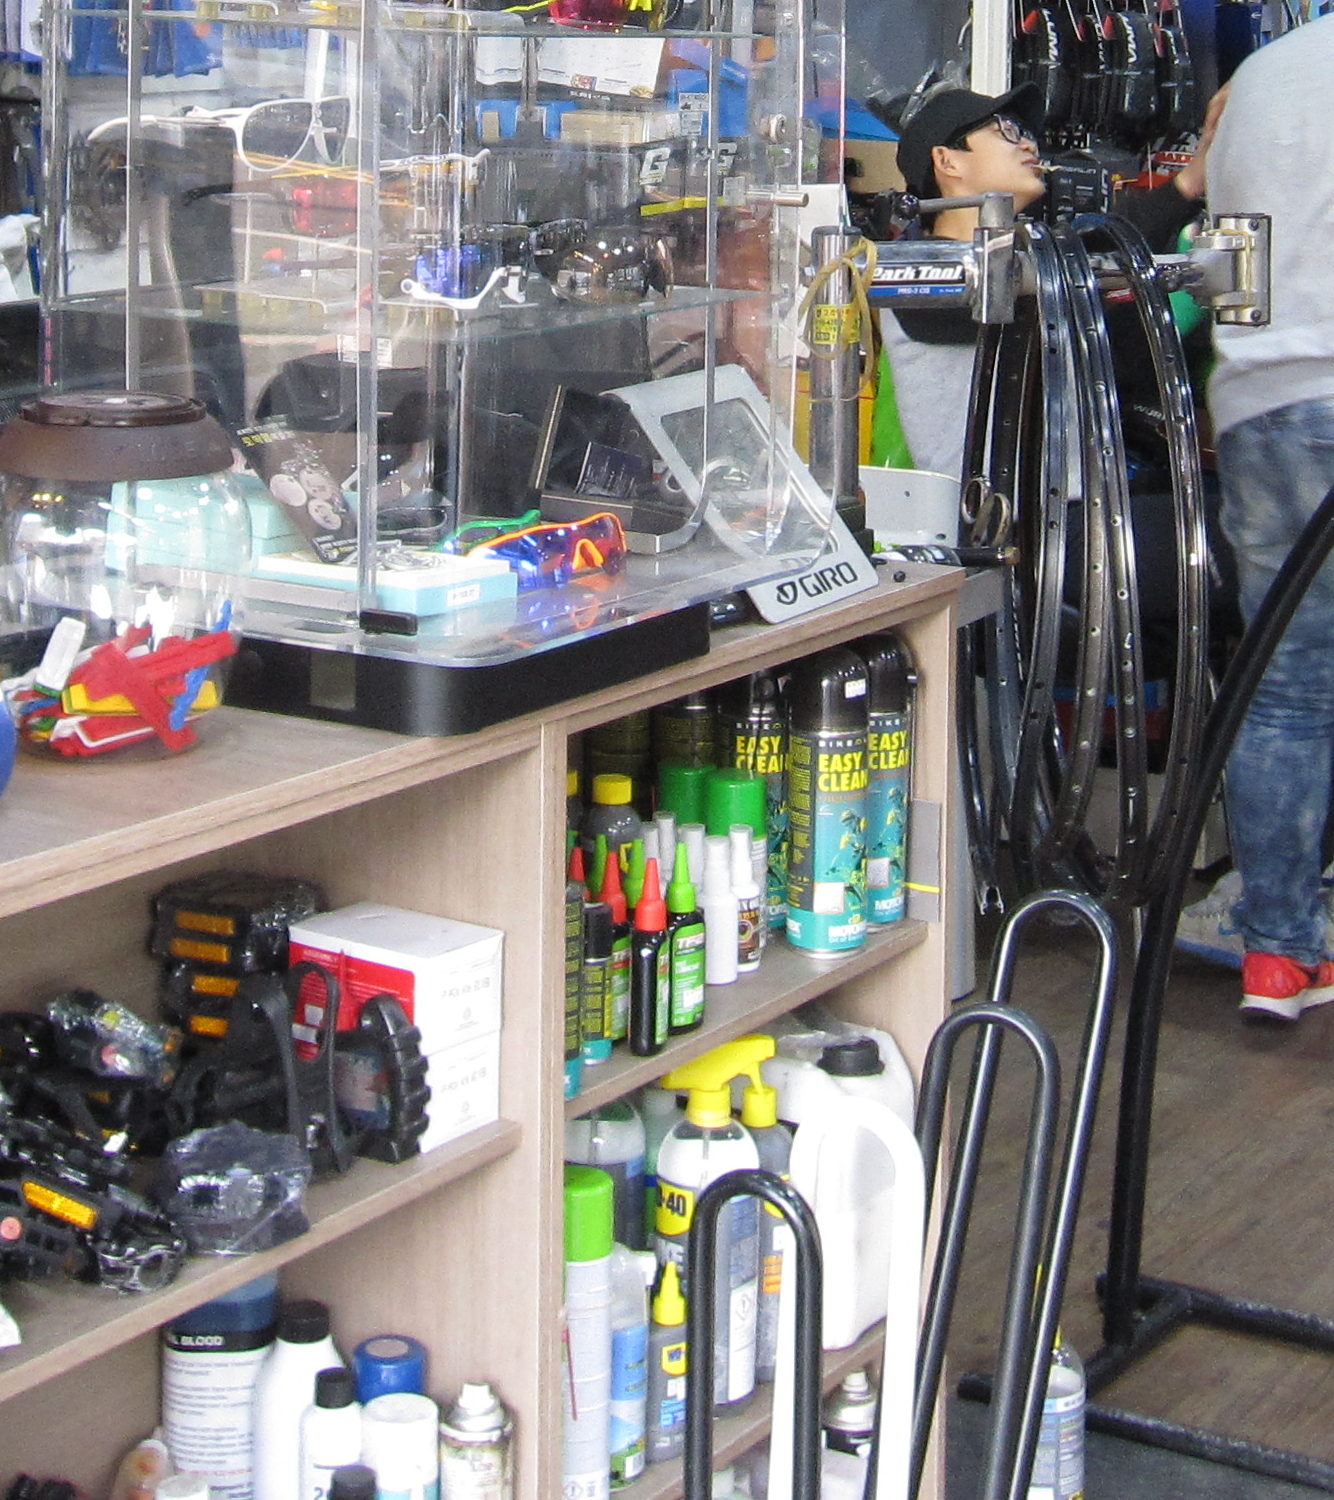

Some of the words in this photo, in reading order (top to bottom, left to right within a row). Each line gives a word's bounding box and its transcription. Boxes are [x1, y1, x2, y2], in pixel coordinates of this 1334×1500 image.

[872, 265, 917, 280] Park
[918, 264, 962, 280] Tool
[800, 560, 858, 599] GIRO
[736, 735, 782, 754] EASY
[819, 738, 853, 748] BIKE
[868, 730, 908, 752] EASY
[818, 752, 863, 773] EASY
[180, 1335, 225, 1347] BLOOD
